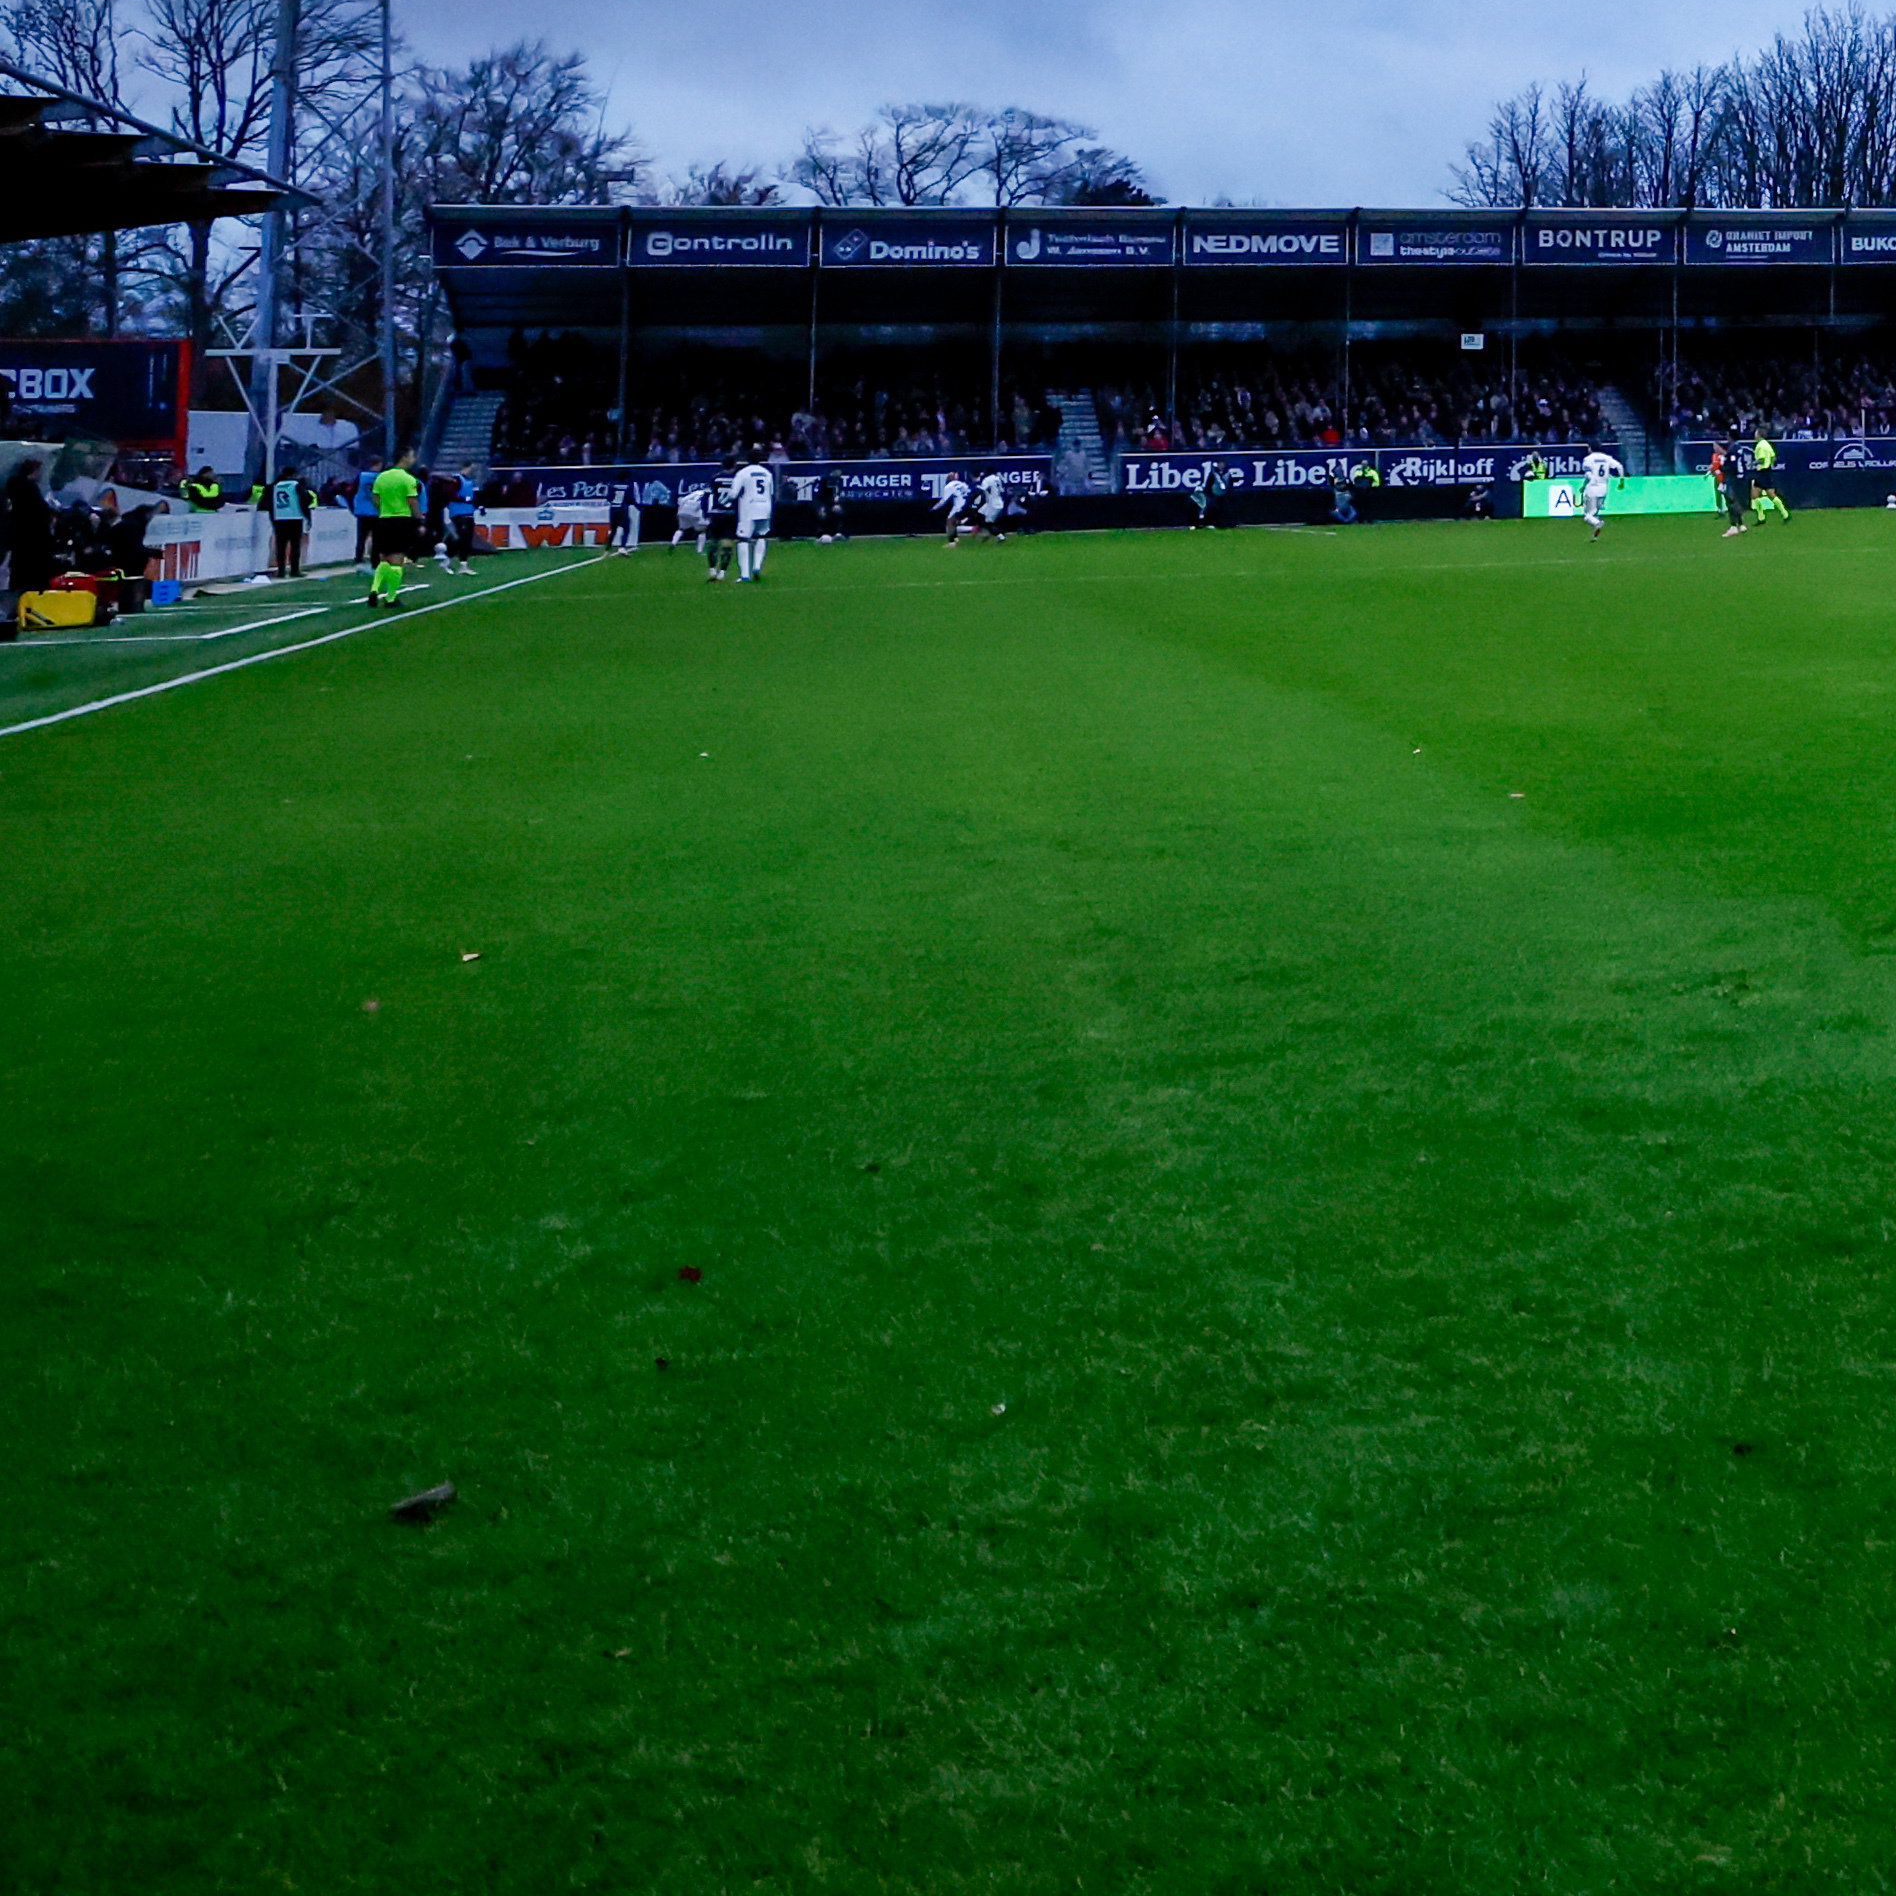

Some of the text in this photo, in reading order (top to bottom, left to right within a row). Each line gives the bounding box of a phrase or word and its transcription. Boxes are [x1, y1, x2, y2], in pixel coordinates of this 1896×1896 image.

[1193, 235, 1339, 253] NEDMOVE
[1538, 229, 1661, 248] BONTRUP
[869, 240, 980, 260] Domino's
[1725, 242, 1791, 253] AMSTERDAM
[1126, 461, 1244, 490] Libele
[1405, 457, 1494, 482] Rijkhoff
[1598, 464, 1606, 477] 6
[536, 482, 565, 497] Les
[756, 479, 765, 495] 5
[840, 475, 912, 487] TANGER
